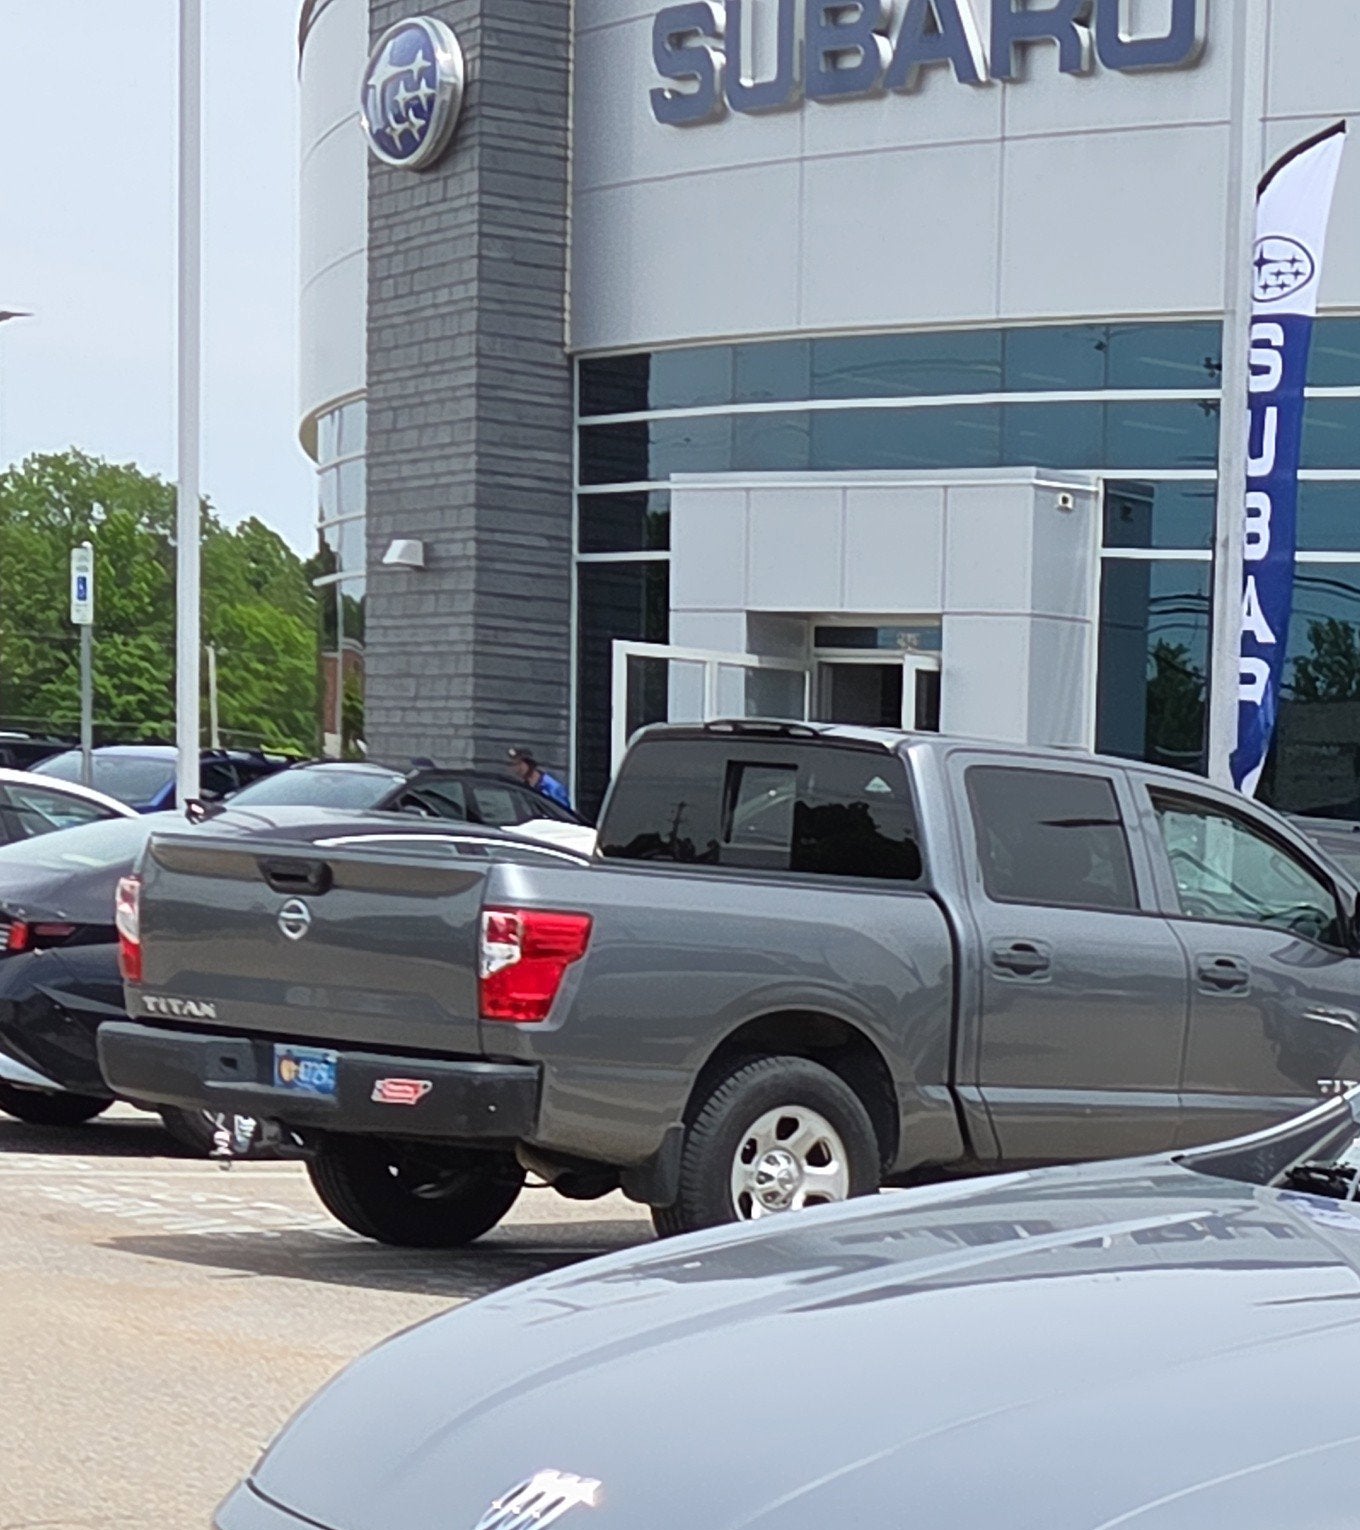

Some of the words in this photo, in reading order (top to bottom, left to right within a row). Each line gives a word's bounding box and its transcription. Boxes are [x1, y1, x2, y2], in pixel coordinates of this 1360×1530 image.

[649, 0, 1200, 125] SUBARU
[142, 995, 217, 1018] TITAN
[1316, 1079, 1358, 1093] TIT
